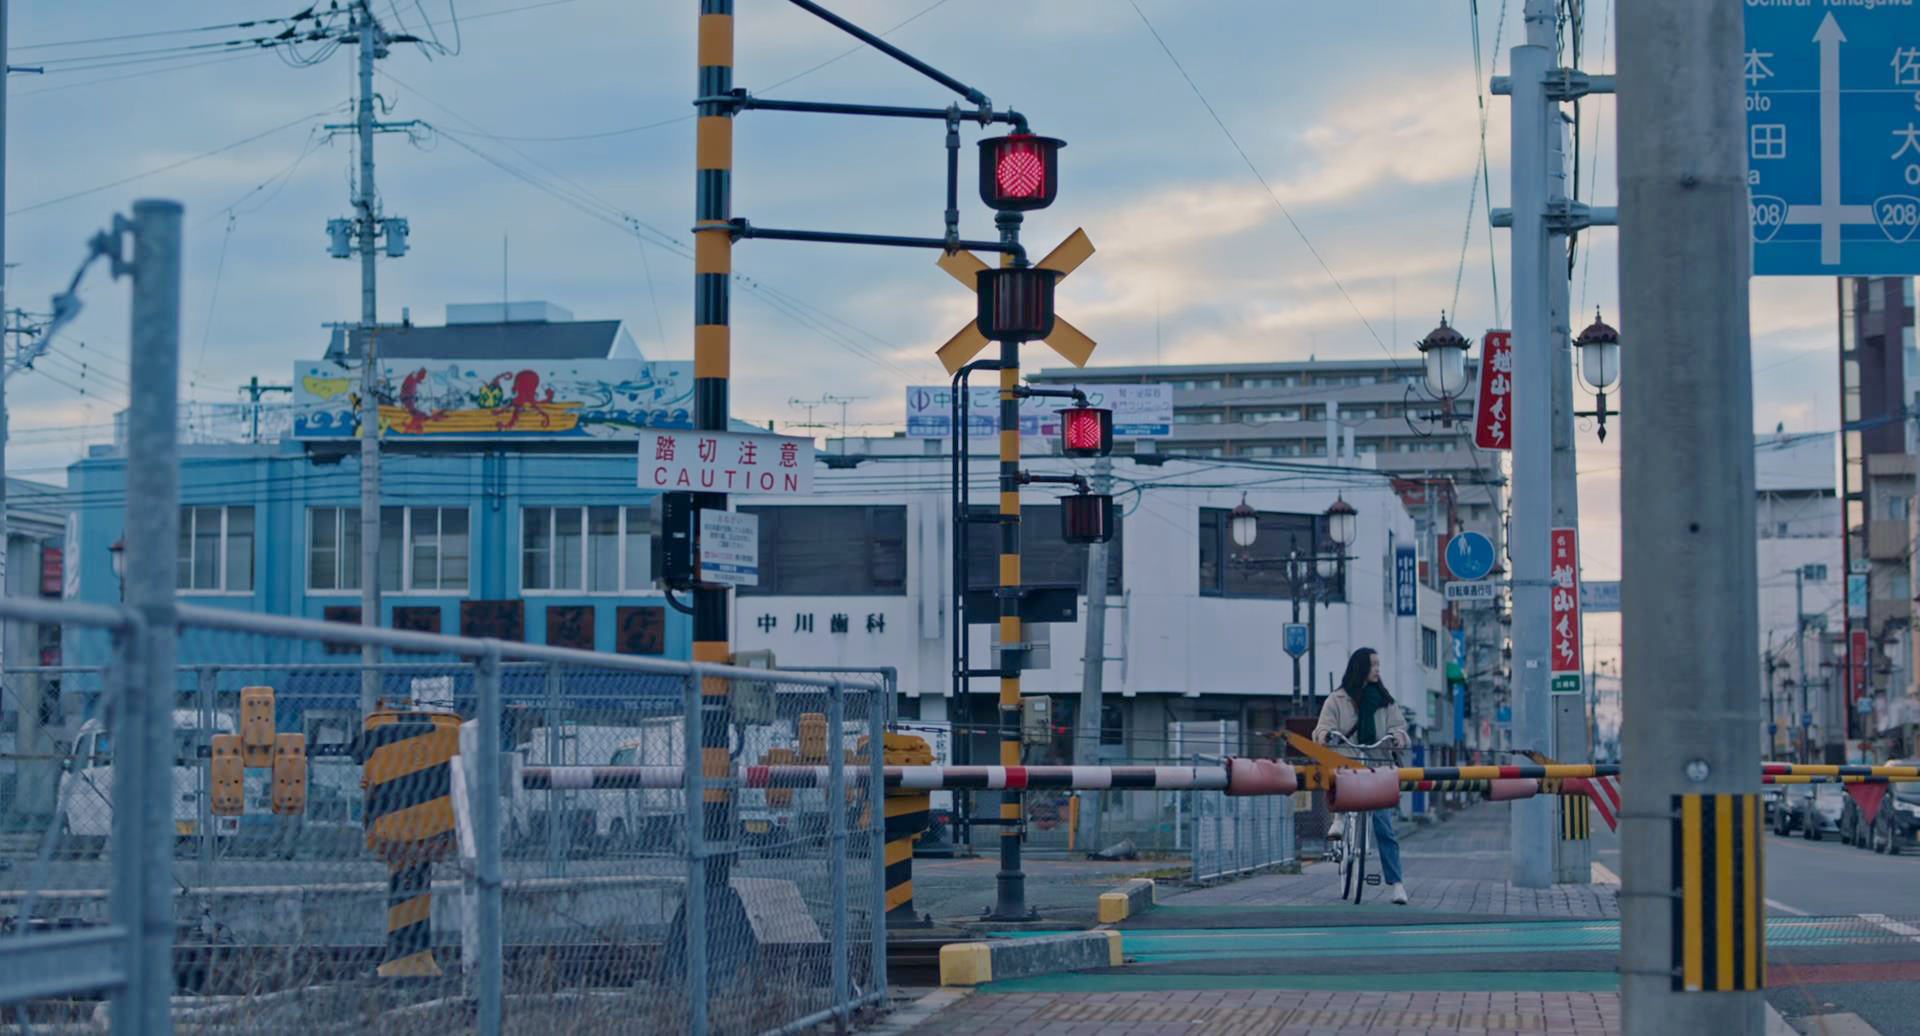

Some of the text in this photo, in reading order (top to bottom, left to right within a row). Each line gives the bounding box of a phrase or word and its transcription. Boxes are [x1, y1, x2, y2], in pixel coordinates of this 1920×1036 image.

[1882, 204, 1917, 225] 208
[655, 436, 799, 468] 踏切注意
[654, 466, 798, 492] CAUTION
[757, 613, 886, 634] 中川歯科
